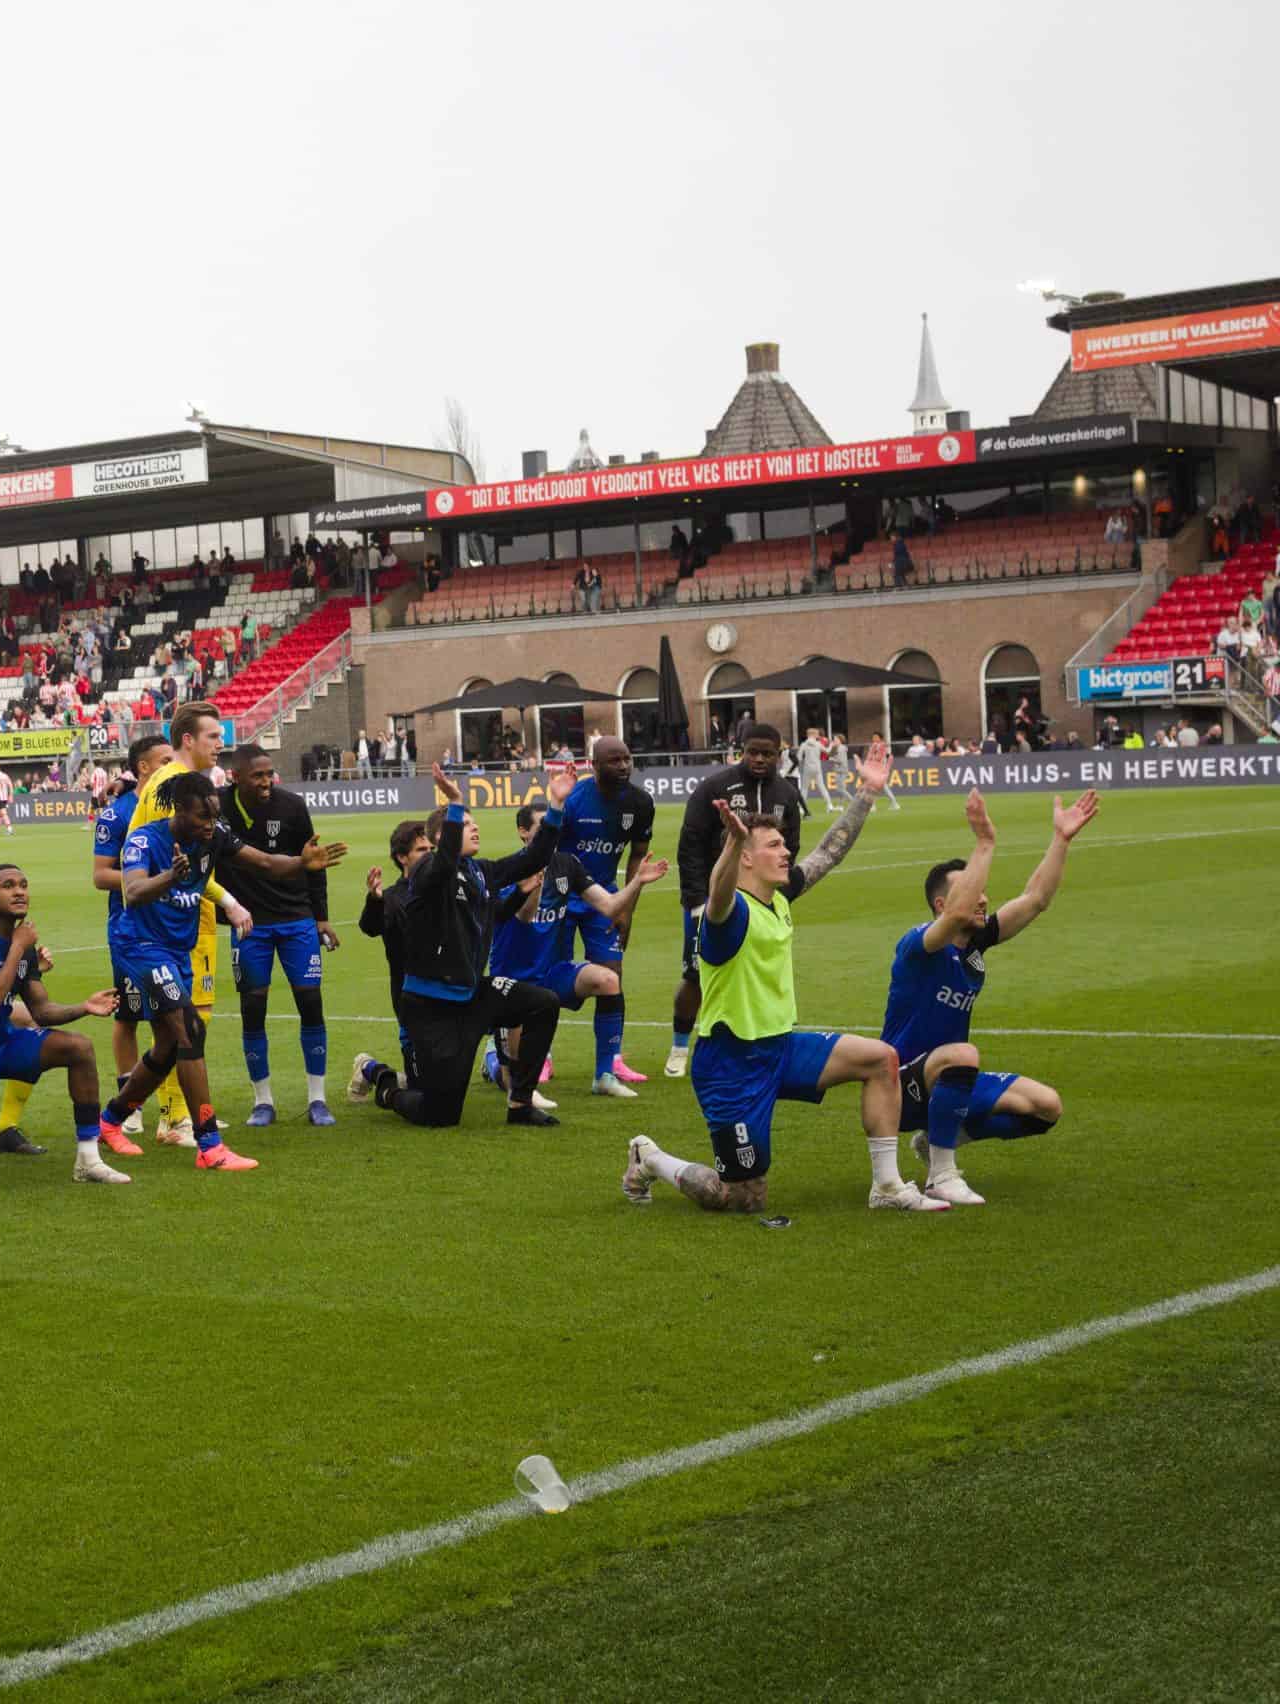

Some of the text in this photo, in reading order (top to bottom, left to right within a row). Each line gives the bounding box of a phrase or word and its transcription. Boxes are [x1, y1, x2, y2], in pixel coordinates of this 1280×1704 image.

[1086, 330, 1170, 352] INVESTEER
[1171, 327, 1187, 341] IN
[1190, 315, 1269, 338] VALENCIA
[993, 424, 1126, 450] de Goudse verzekeringen
[94, 454, 182, 481] HECOTHERM
[93, 474, 185, 493] GREENHOUSE SUPPLY
[496, 487, 512, 506] DE
[514, 477, 588, 505] HEMELPOORT
[592, 469, 654, 496] VERDACHT
[658, 466, 690, 488] VEEL
[693, 463, 720, 484] WEG
[724, 458, 762, 482] HEEFT
[766, 455, 793, 477] VAN
[796, 452, 821, 474] HET
[325, 501, 422, 522] de Goudse verzekeringen
[1176, 663, 1203, 685] 21
[89, 728, 107, 744] 20
[947, 766, 994, 786] VAN
[1005, 763, 1070, 784] HIJS-
[1081, 761, 1113, 781] EN
[1124, 756, 1280, 780] HEFWERKT
[15, 803, 30, 817] IN
[576, 838, 613, 854] asito
[151, 965, 174, 985] 44
[735, 1122, 750, 1144] 9
